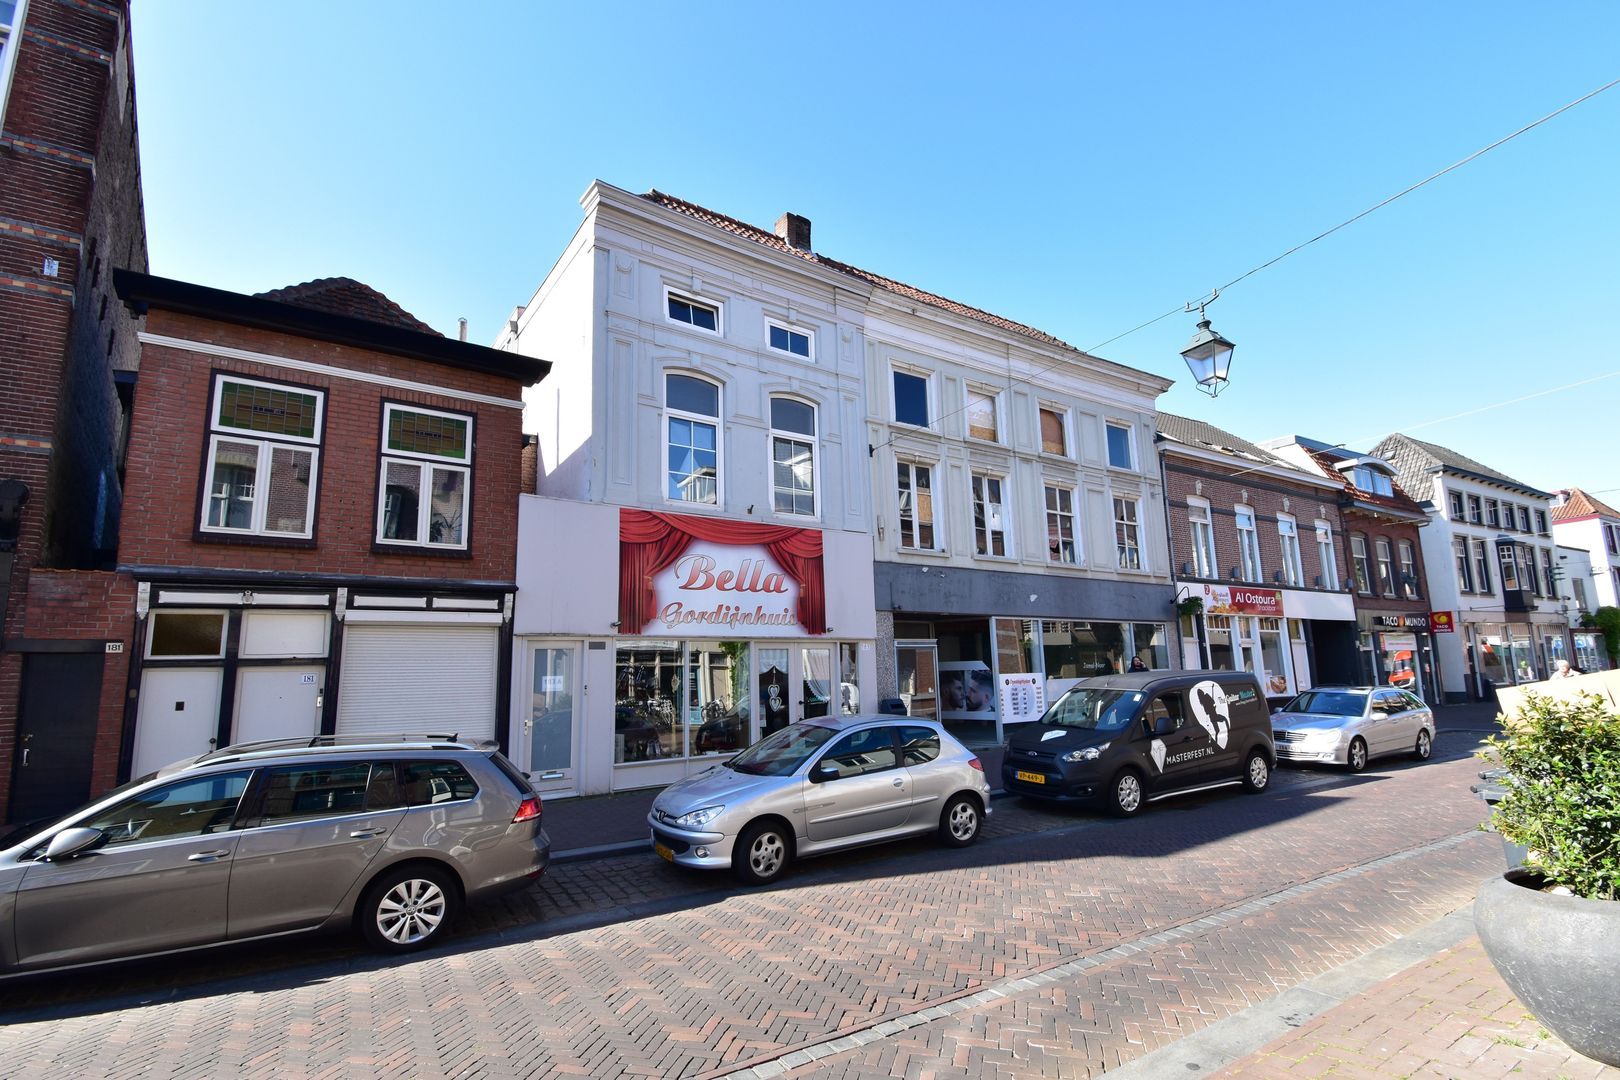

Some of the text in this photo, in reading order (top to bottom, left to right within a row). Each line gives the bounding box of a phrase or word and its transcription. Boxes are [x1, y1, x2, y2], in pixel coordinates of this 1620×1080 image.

[674, 554, 788, 593] Bella
[1235, 592, 1244, 603] Al
[1245, 593, 1276, 605] Ostoura
[658, 601, 798, 630] Gordijnhuis
[1382, 616, 1426, 627] TACO MUNDO
[303, 675, 314, 683] 181
[1166, 747, 1215, 765] MASTERFEST.NL
